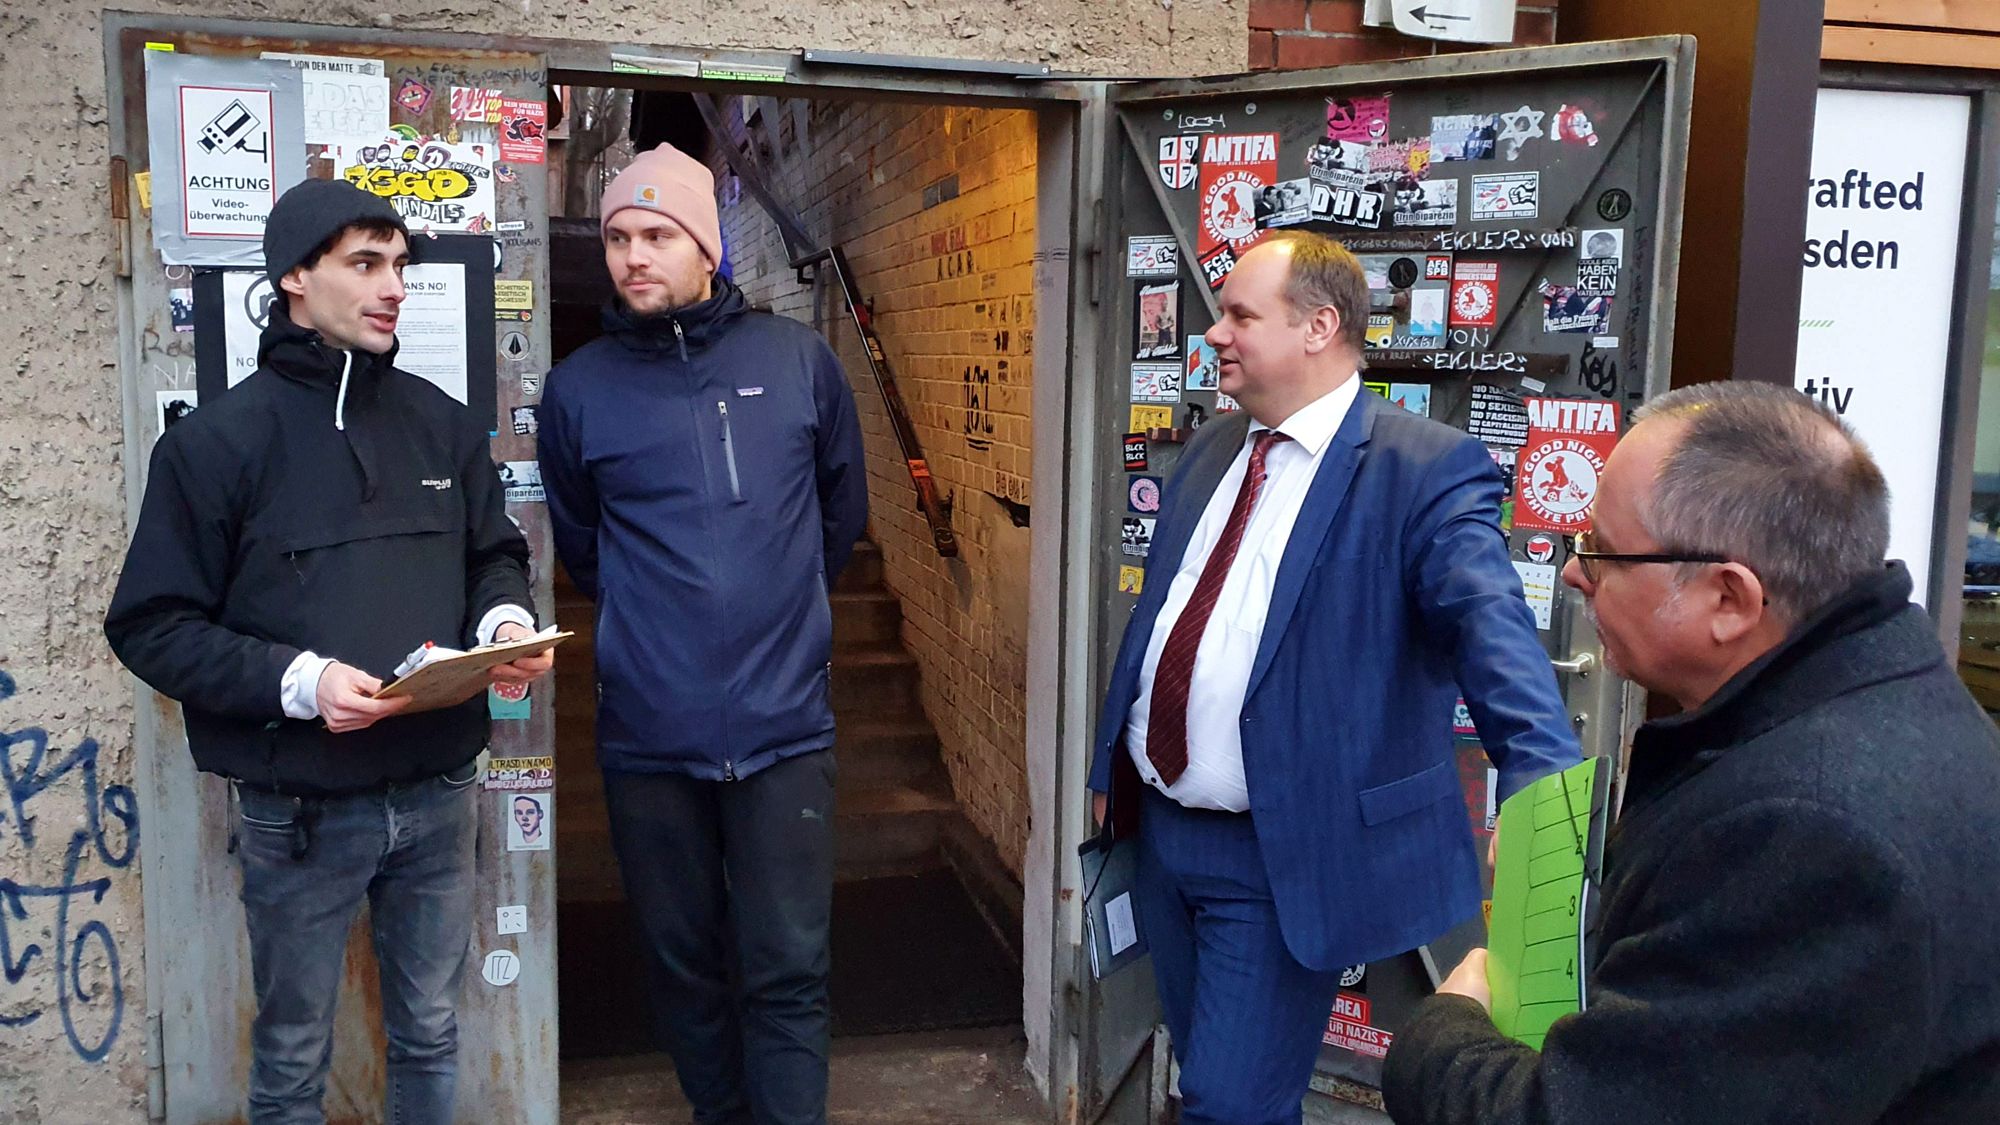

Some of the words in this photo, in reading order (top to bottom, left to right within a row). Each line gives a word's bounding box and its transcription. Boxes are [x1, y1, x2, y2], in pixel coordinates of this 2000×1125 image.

[312, 61, 326, 71] DER
[329, 63, 353, 73] MATTE
[486, 99, 503, 110] TOP
[519, 102, 542, 110] VIERTEL
[1164, 142, 1174, 156] 1
[1203, 135, 1276, 162] ANTIFA
[1164, 167, 1173, 183] 9
[1182, 166, 1191, 182] 7
[189, 176, 270, 190] ACHTUNG
[1205, 172, 1235, 204] GOOD
[212, 198, 248, 208] Video-
[394, 197, 465, 223] VANDALS
[1311, 185, 1378, 221] DHR
[190, 210, 267, 224] überwachung
[1202, 248, 1232, 273] FCK
[1427, 260, 1448, 268] AFA
[1209, 259, 1235, 283] AFD
[1426, 267, 1448, 275] SPB
[1578, 265, 1617, 275] HABEN
[428, 282, 447, 290] NO!
[1455, 281, 1473, 297] GOOD
[1475, 281, 1493, 298] NIGHT
[1577, 276, 1616, 290] KEIN
[1455, 304, 1472, 320] WHITE
[1474, 304, 1492, 319] PRIDE
[1472, 401, 1486, 409] NO
[1471, 411, 1484, 419] NO
[1528, 400, 1616, 432] ANTIFA
[1125, 444, 1144, 452] BLCK
[1524, 440, 1564, 472] GOOD
[1126, 453, 1144, 461] BLCK
[1522, 487, 1561, 523] WHITE
[1584, 777, 1589, 795] 1
[1575, 834, 1583, 856] 2
[1569, 895, 1576, 918] 3
[1566, 959, 1573, 980] 4
[1346, 1025, 1378, 1043] NAZIS
